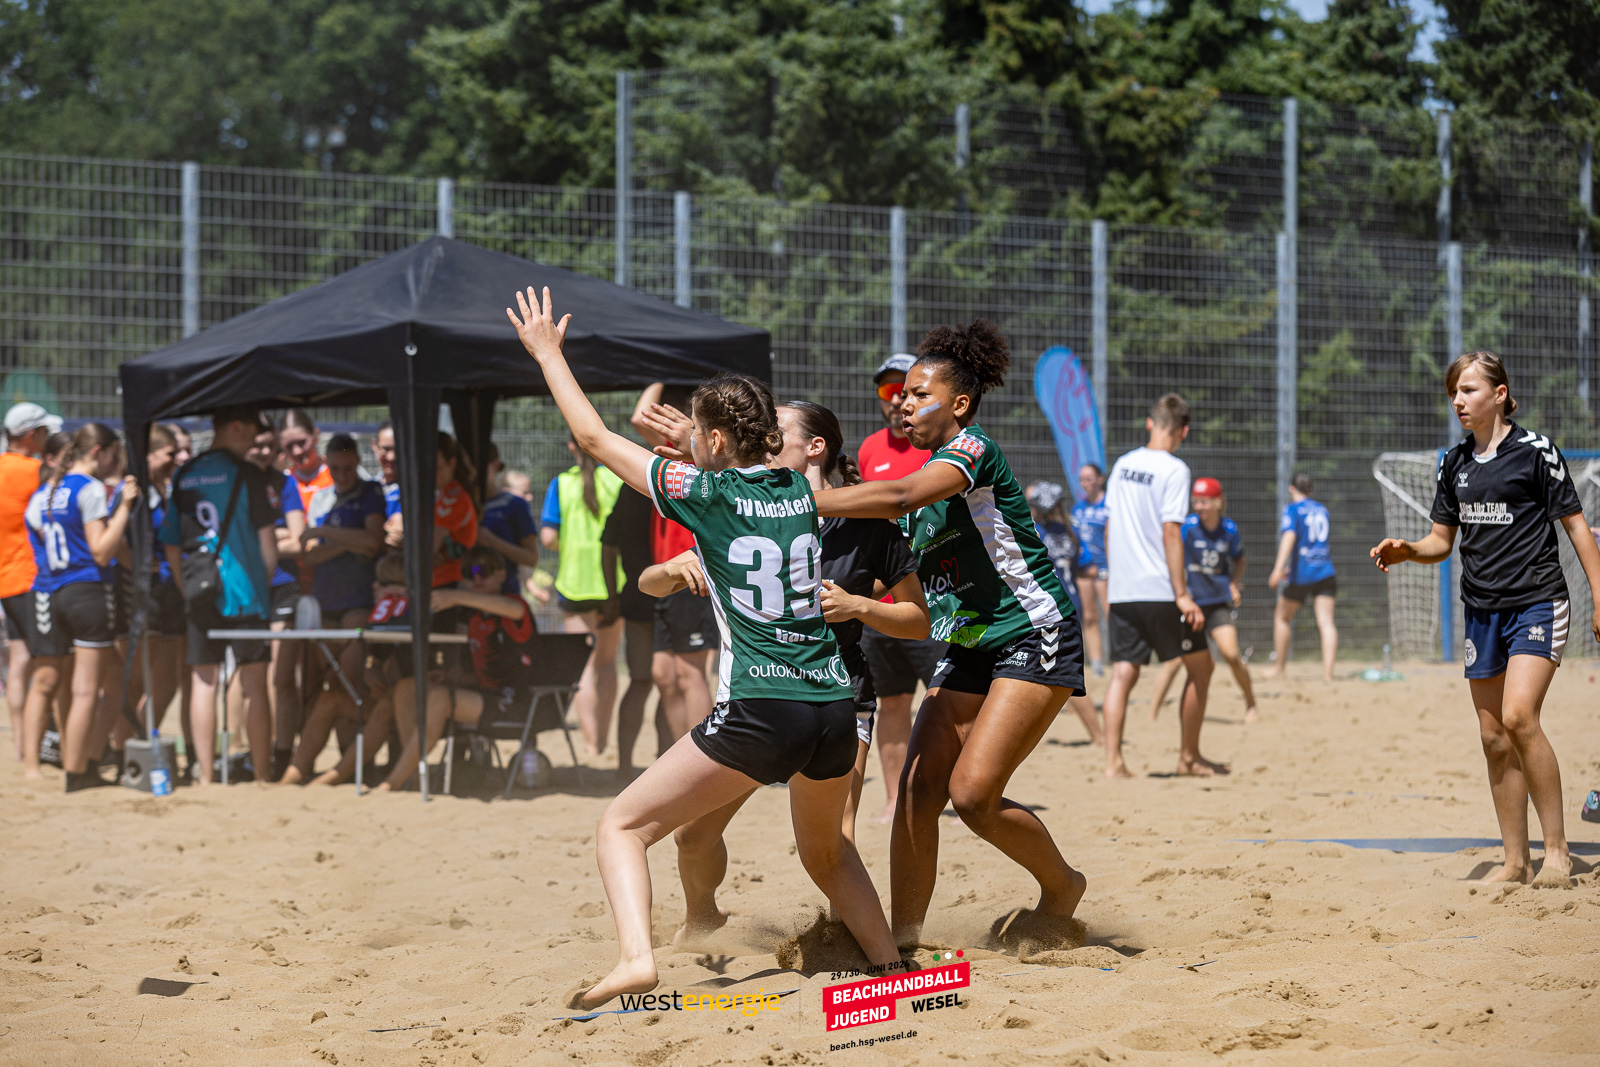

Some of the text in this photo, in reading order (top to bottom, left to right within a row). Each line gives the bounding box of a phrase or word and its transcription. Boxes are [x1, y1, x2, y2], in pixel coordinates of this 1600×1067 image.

[196, 500, 219, 533] 9
[734, 497, 753, 517] TV
[1486, 502, 1507, 514] TEAM
[1304, 512, 1329, 542] 10
[42, 521, 70, 571] 10
[728, 533, 822, 623] 39
[372, 599, 391, 621] 5
